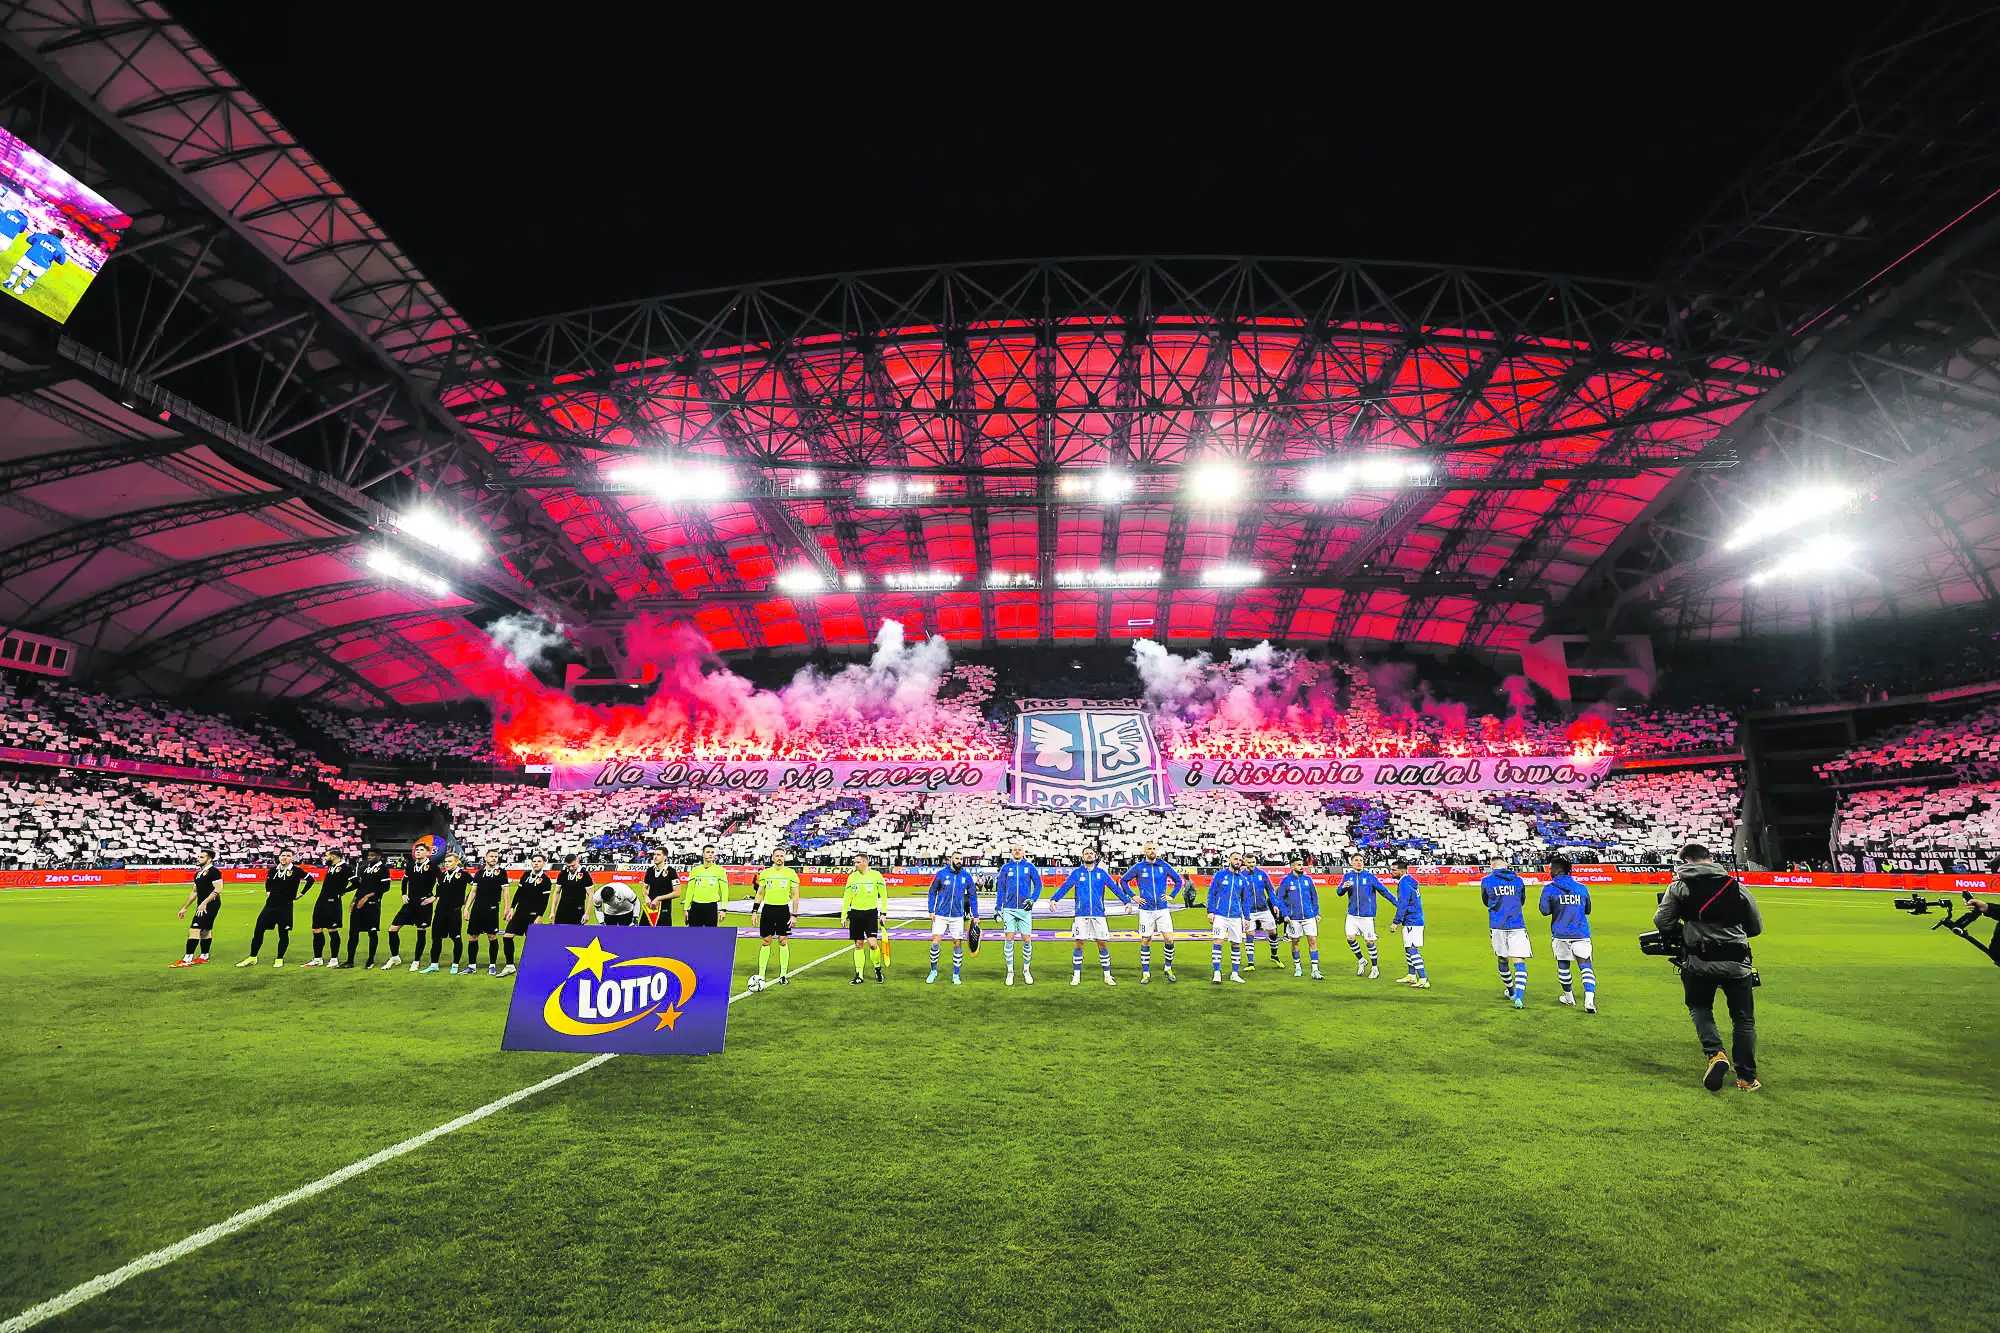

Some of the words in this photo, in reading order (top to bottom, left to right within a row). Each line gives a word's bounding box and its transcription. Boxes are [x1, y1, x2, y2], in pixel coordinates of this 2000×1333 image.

[1023, 700, 1069, 709] KKS
[1081, 699, 1139, 707] LECH
[595, 761, 645, 787] Na
[779, 763, 834, 789] się
[1185, 761, 1203, 786] i
[1213, 761, 1364, 785] historia
[1374, 759, 1481, 785] nadal
[1031, 782, 1151, 811] POZNAŃ
[45, 874, 69, 883] Zero
[72, 873, 102, 882] Cukru
[1955, 880, 1987, 888] Nowa
[1494, 886, 1515, 896] LECH
[1559, 895, 1581, 905] LECH
[578, 972, 668, 1018] LOTTO
